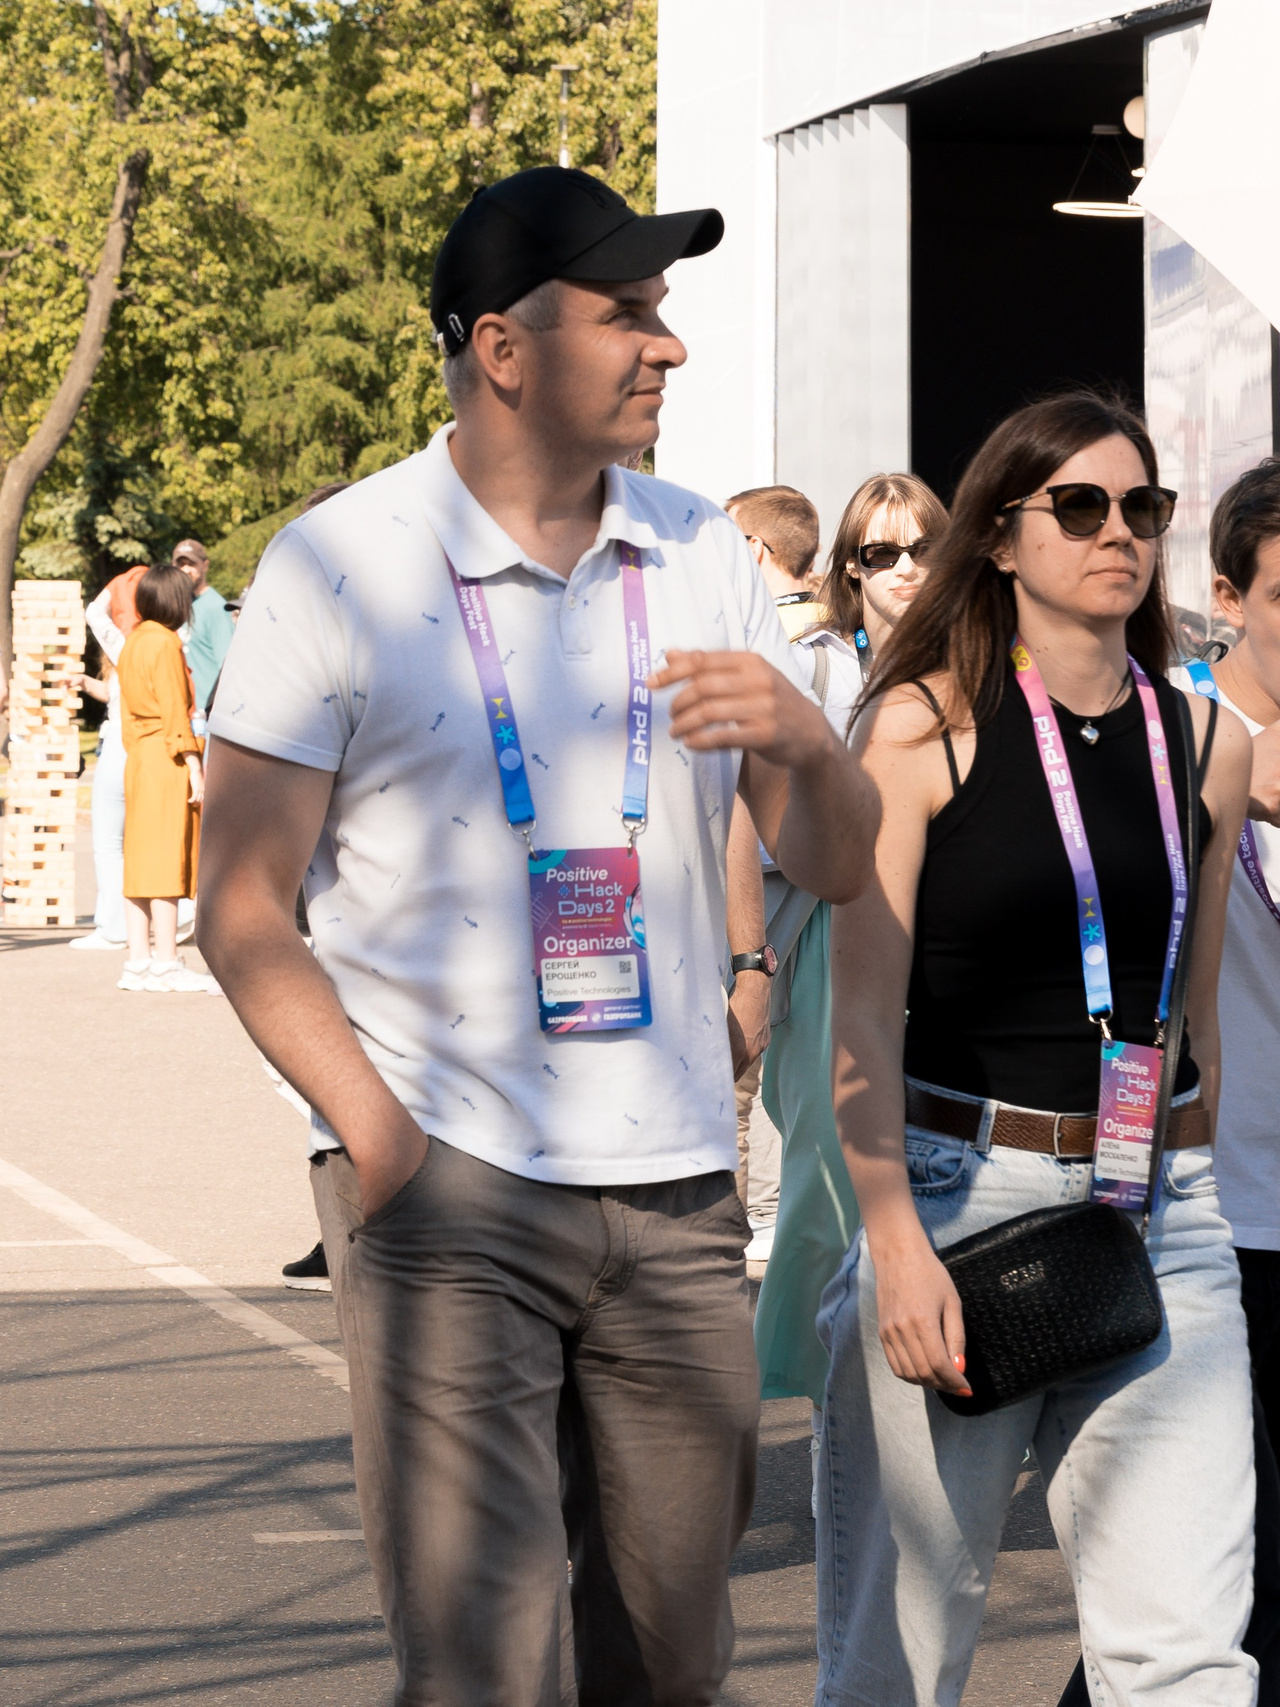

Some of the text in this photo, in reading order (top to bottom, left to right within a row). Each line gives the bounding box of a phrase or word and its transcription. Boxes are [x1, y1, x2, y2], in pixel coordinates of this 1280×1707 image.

[459, 586, 478, 631] Days Fest
[468, 585, 491, 647] Positive Hack
[632, 685, 648, 766] phd 2
[1033, 715, 1069, 787] phd 2
[1055, 792, 1072, 834] Days Fest
[1063, 790, 1084, 849] Positive Hack
[546, 866, 608, 883] Positive
[574, 882, 623, 898] Hack
[558, 899, 615, 917] Days 2
[543, 933, 633, 955] Organizer
[545, 960, 580, 970] СЕРГЕЙ
[546, 971, 597, 981] ЕРОЩЕНКО
[547, 986, 631, 997] Positive Technologies
[1111, 1057, 1150, 1076] Positive
[1127, 1074, 1157, 1092] Hack
[1116, 1088, 1151, 1107] Days 2
[1103, 1117, 1154, 1140] Organize
